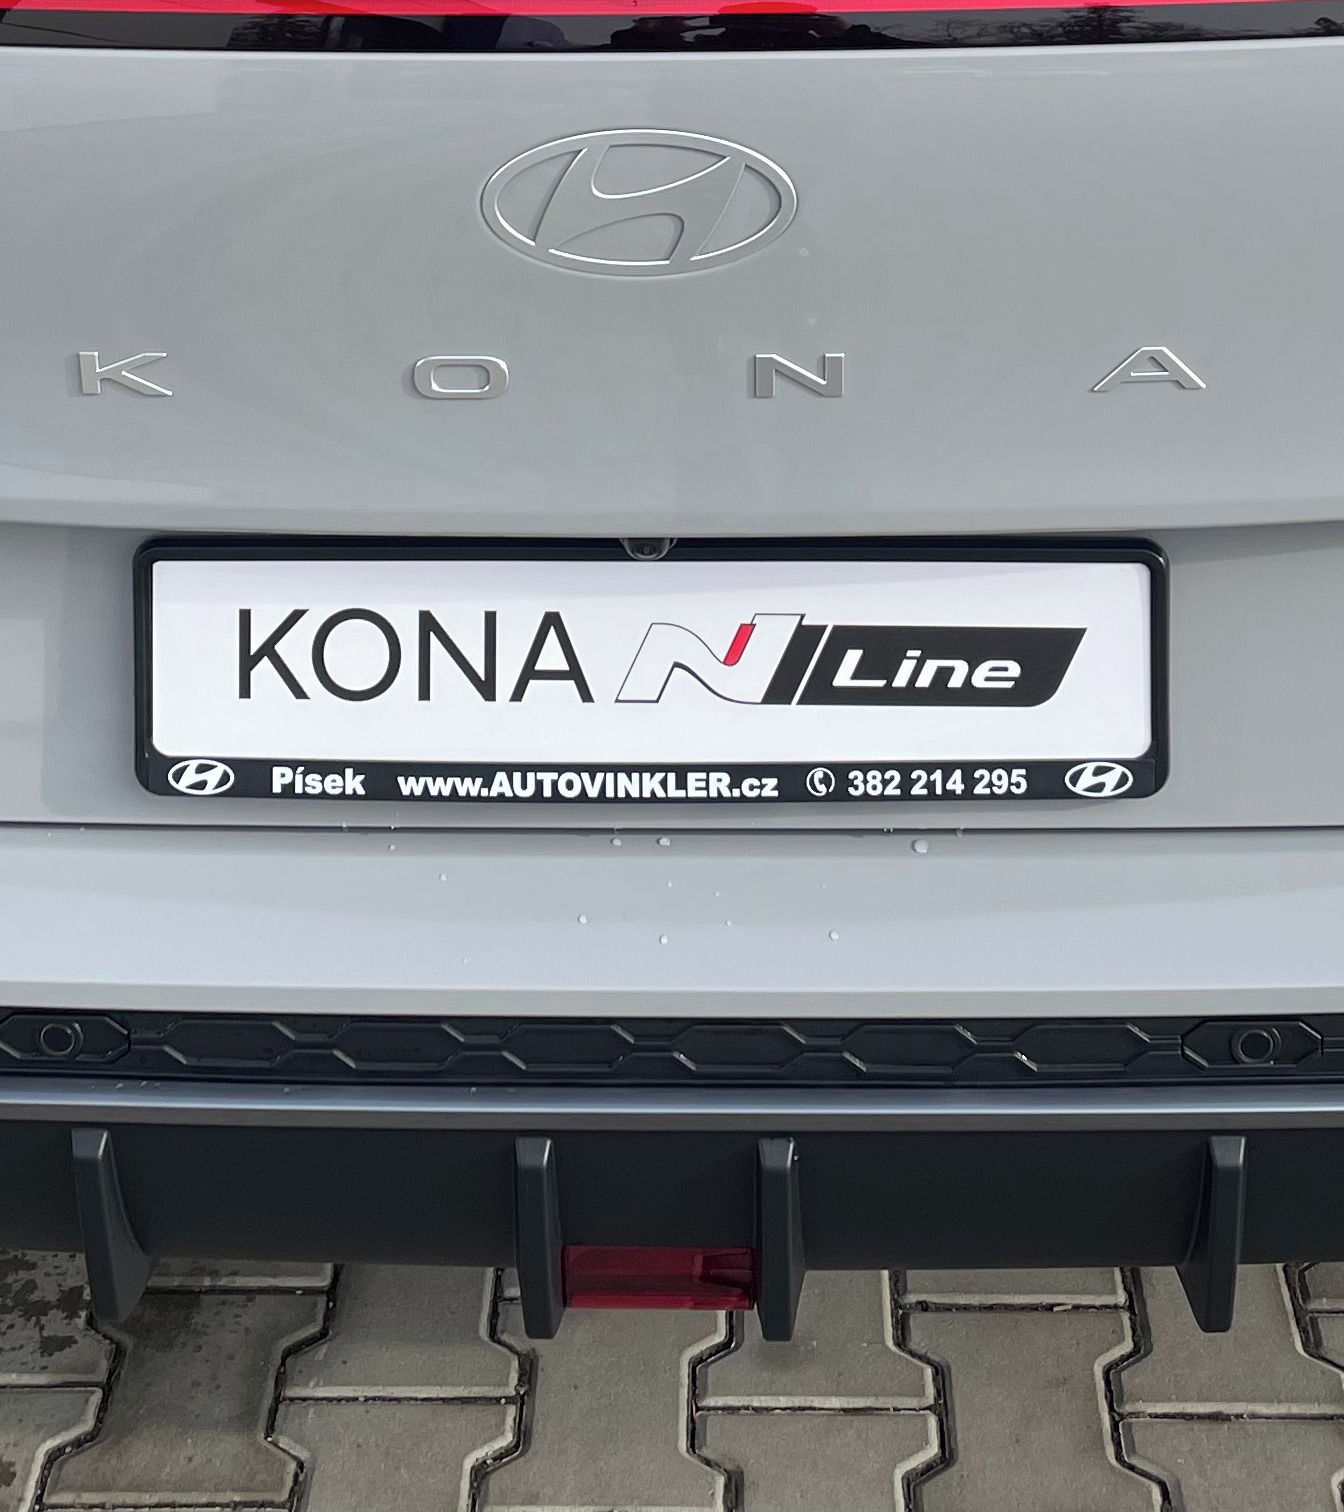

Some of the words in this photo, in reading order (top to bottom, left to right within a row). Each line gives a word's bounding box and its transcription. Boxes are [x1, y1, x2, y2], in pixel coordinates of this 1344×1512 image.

[78, 346, 1206, 399] KONA
[238, 607, 596, 703] KONA
[832, 649, 1022, 688] Line
[271, 765, 366, 796] Písek
[397, 770, 779, 799] www.AUTOVINKLER.cz
[848, 769, 901, 796] 382
[911, 769, 965, 796] 214
[974, 768, 1028, 795] 295
